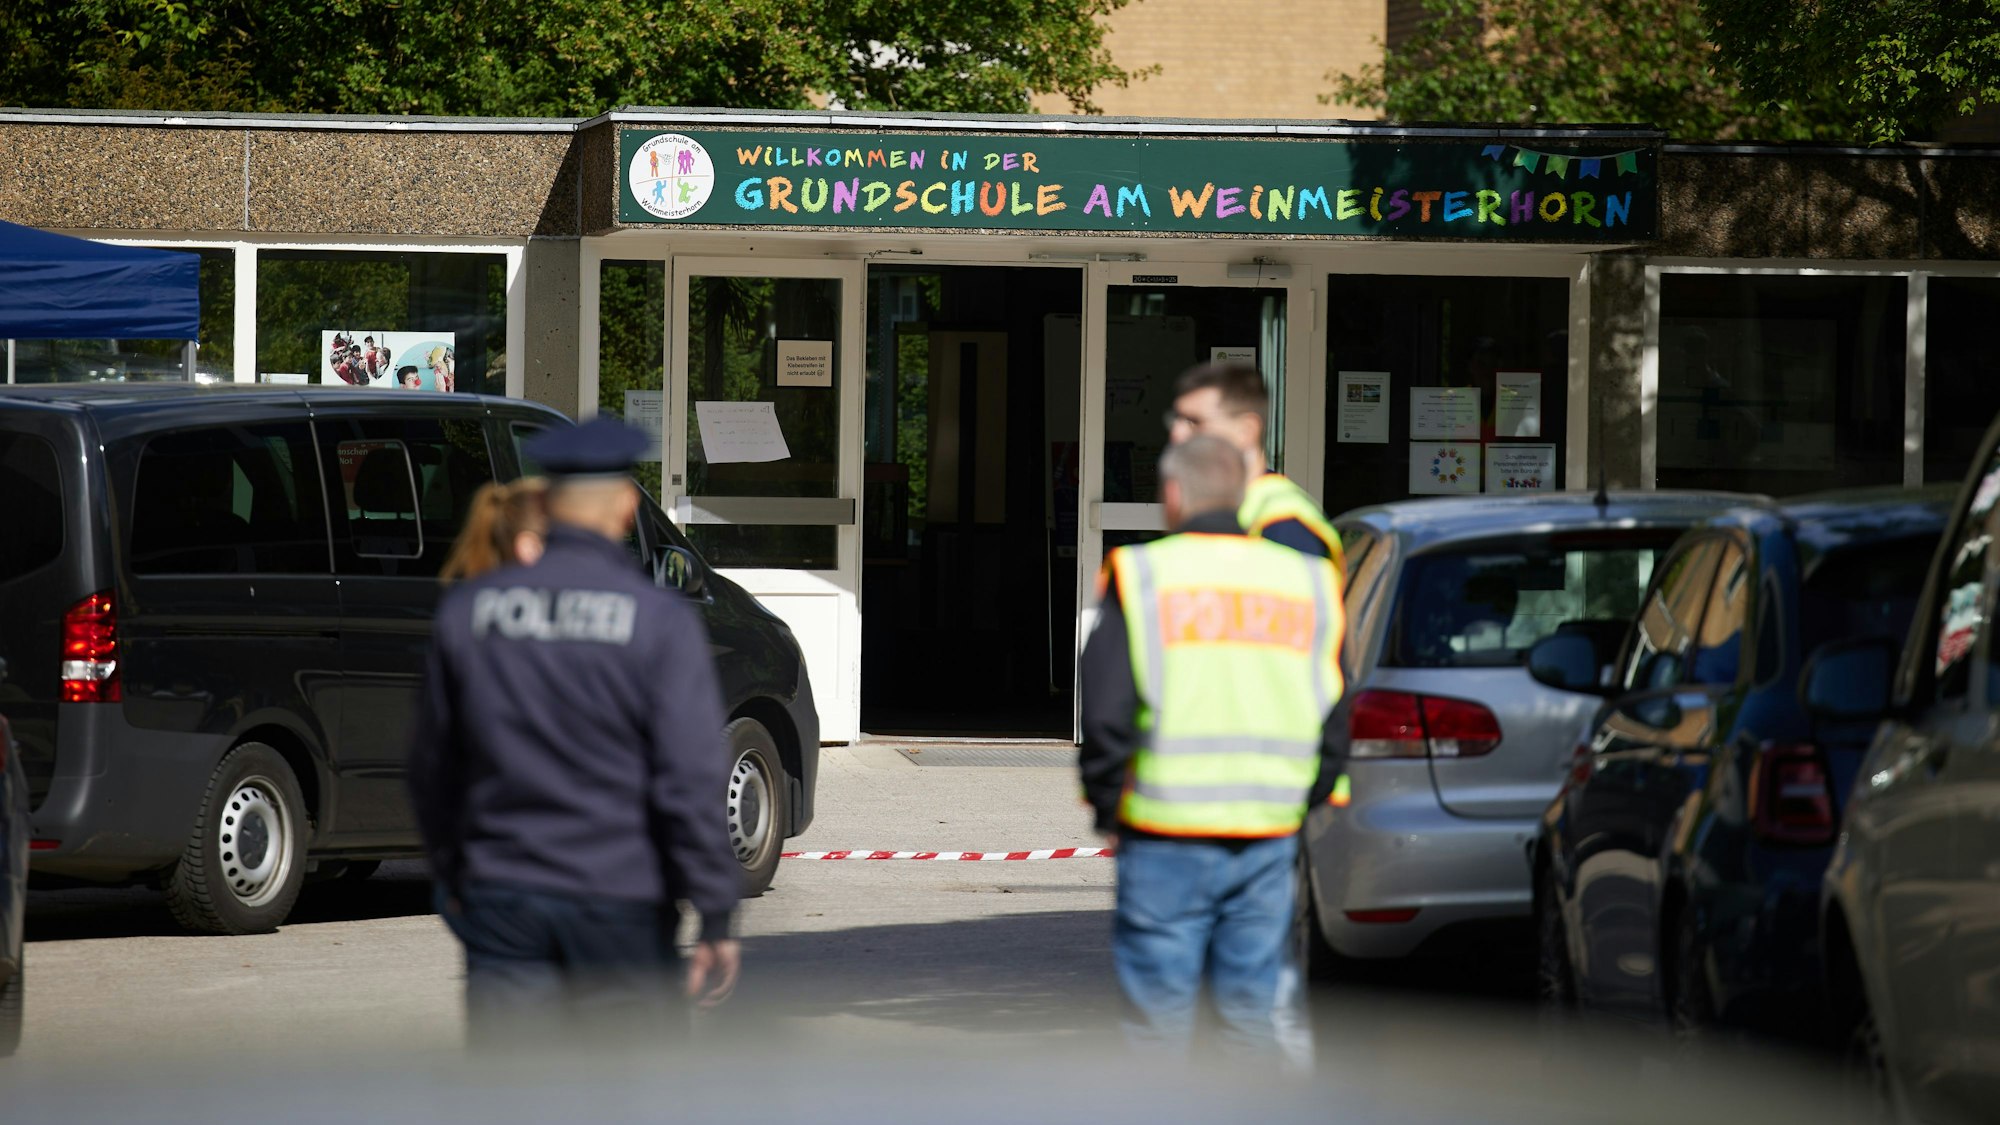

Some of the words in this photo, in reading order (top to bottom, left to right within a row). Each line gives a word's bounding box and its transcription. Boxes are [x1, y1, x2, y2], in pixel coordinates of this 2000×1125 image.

[642, 136, 689, 152] Grundschule
[691, 143, 702, 154] am
[984, 152, 1039, 173] DER
[641, 198, 702, 216] Weinmeisterhorn
[735, 176, 1067, 216] GRUNDSCHULE
[1083, 184, 1151, 218] AM
[472, 587, 637, 645] POLIZEI
